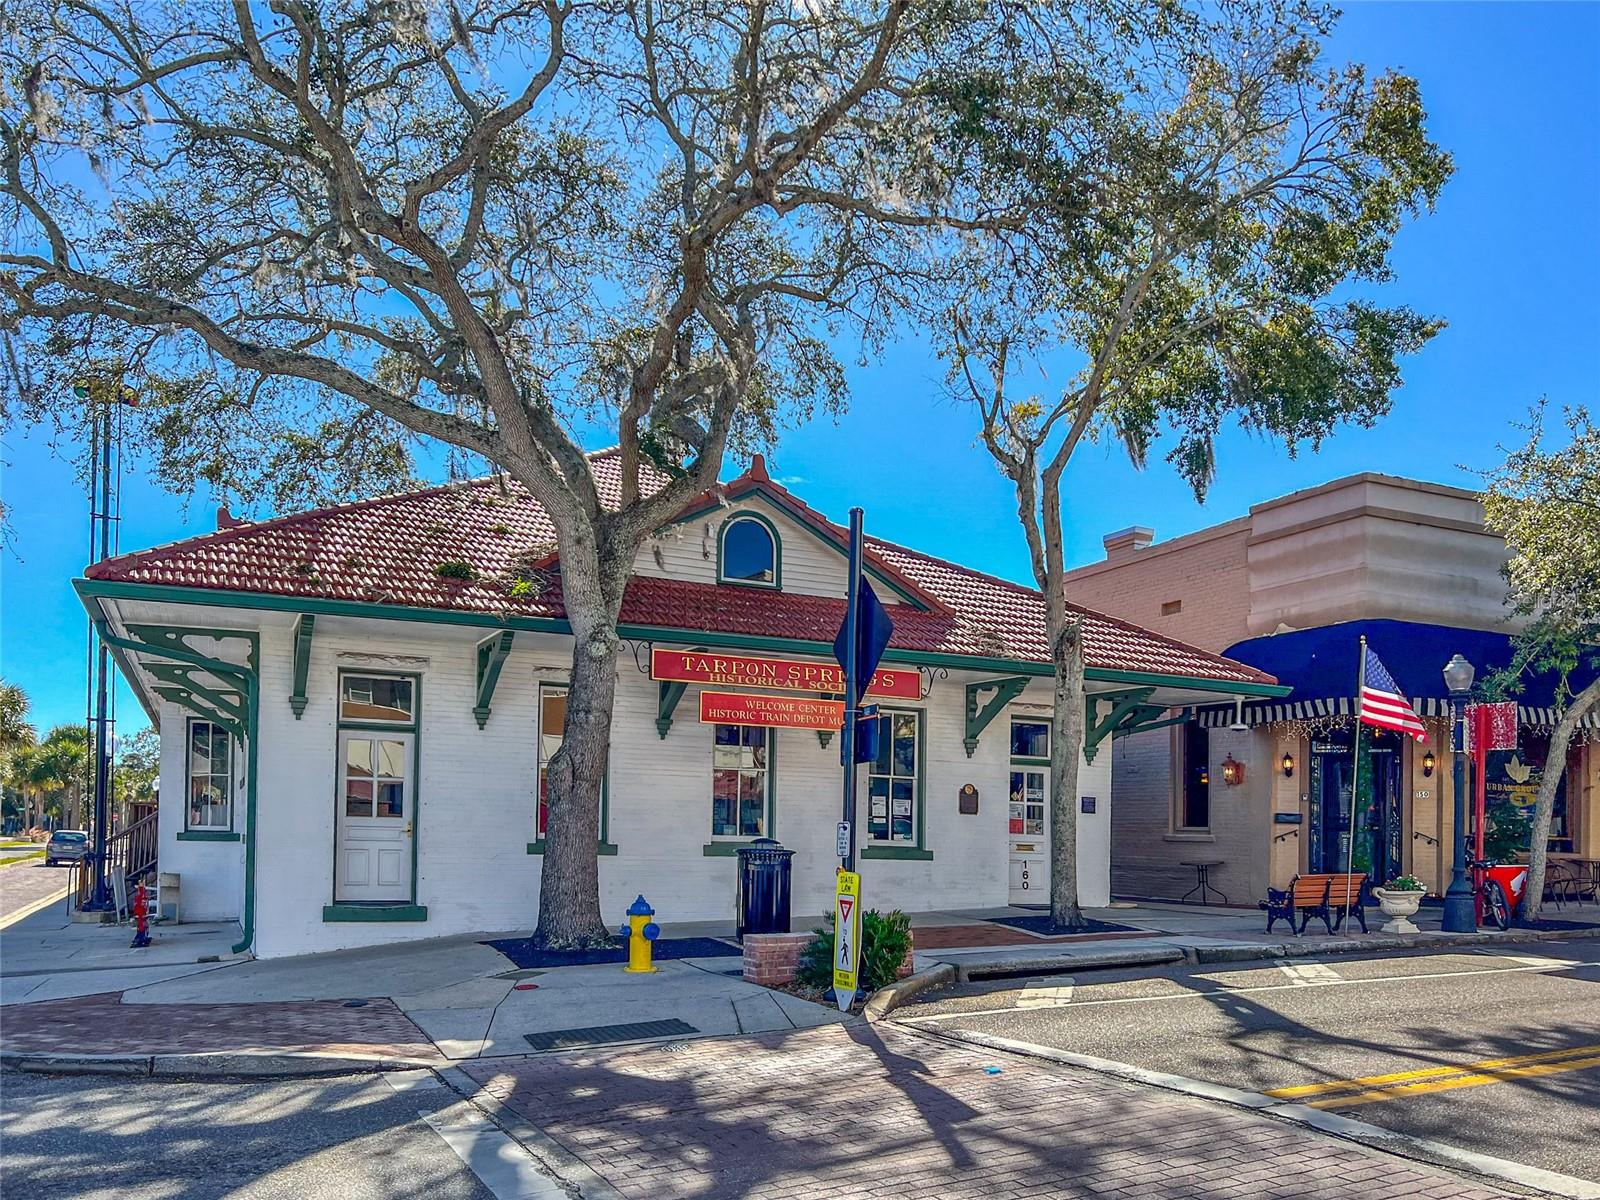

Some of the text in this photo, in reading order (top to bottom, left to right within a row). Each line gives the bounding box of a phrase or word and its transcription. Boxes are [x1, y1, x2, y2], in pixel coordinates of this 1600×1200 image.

[681, 656, 894, 687] TARPON SPRIGS
[709, 673, 803, 689] HISTORICAL
[745, 700, 836, 715] WELCOME CENTER
[709, 708, 758, 720] HISTORIC
[759, 711, 790, 722] TRAIN
[793, 714, 825, 725] DEPOT
[840, 876, 854, 884] STATE
